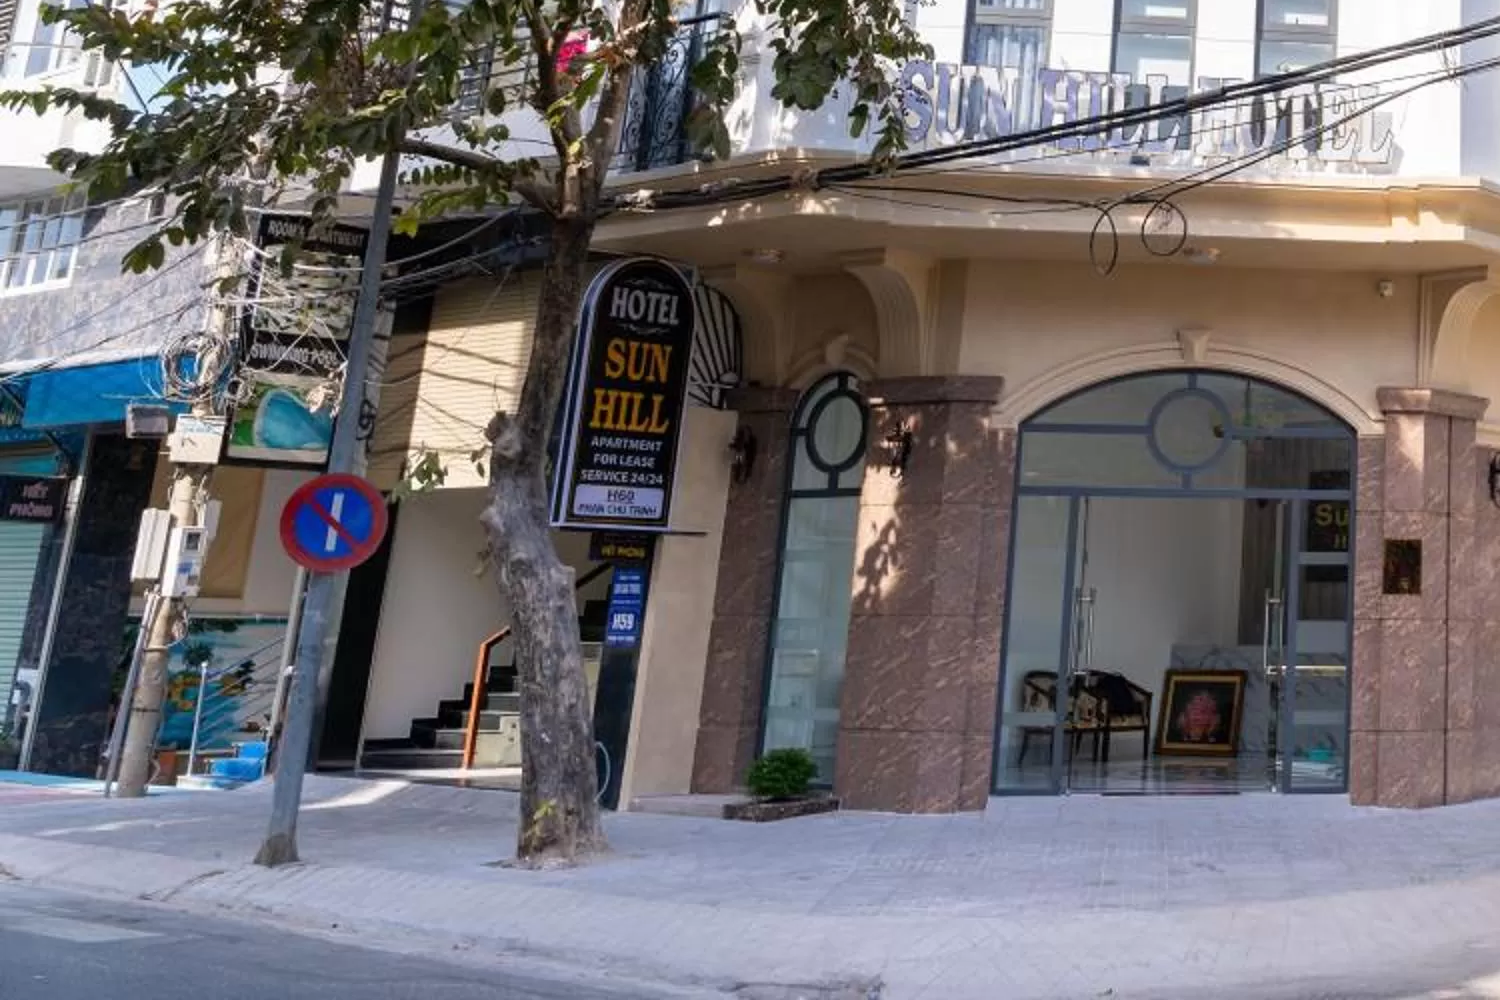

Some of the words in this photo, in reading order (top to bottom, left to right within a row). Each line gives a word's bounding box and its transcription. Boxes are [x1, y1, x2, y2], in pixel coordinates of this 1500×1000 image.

[898, 60, 1020, 148] SUN
[1038, 67, 1190, 155] HILL
[1197, 75, 1396, 164] HOTEL
[610, 286, 679, 325] HOTEL
[605, 337, 673, 384] SUN
[590, 387, 670, 434] HILL
[591, 436, 663, 452] APARTMENT
[593, 453, 617, 465] FOR
[620, 454, 656, 468] LEASE
[580, 468, 629, 483] SERVICE
[630, 471, 663, 485] 24/24
